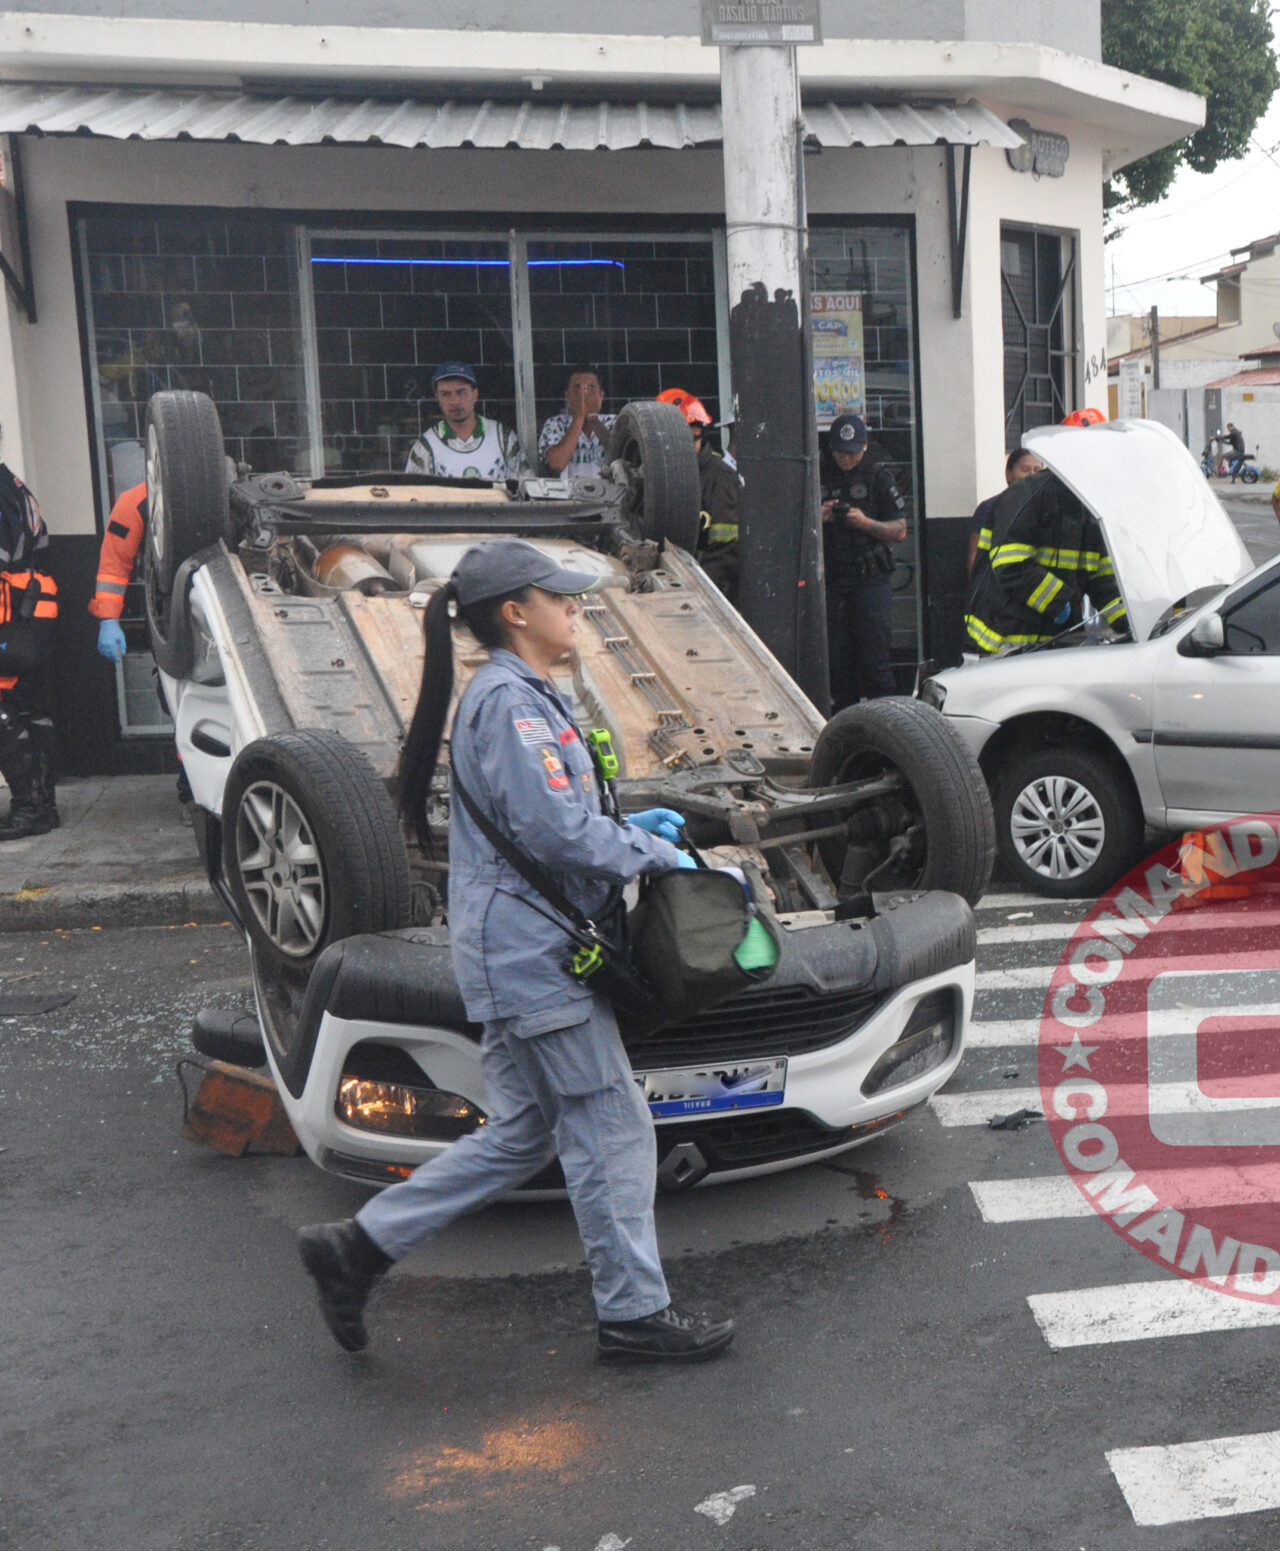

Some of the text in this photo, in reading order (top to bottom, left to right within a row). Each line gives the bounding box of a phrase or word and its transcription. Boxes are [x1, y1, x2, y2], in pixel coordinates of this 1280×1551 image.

[762, 6, 805, 22] MARTINS
[1032, 134, 1068, 157] BOTECO
[827, 296, 860, 310] AQUI
[683, 1099, 711, 1109] BRASIL
